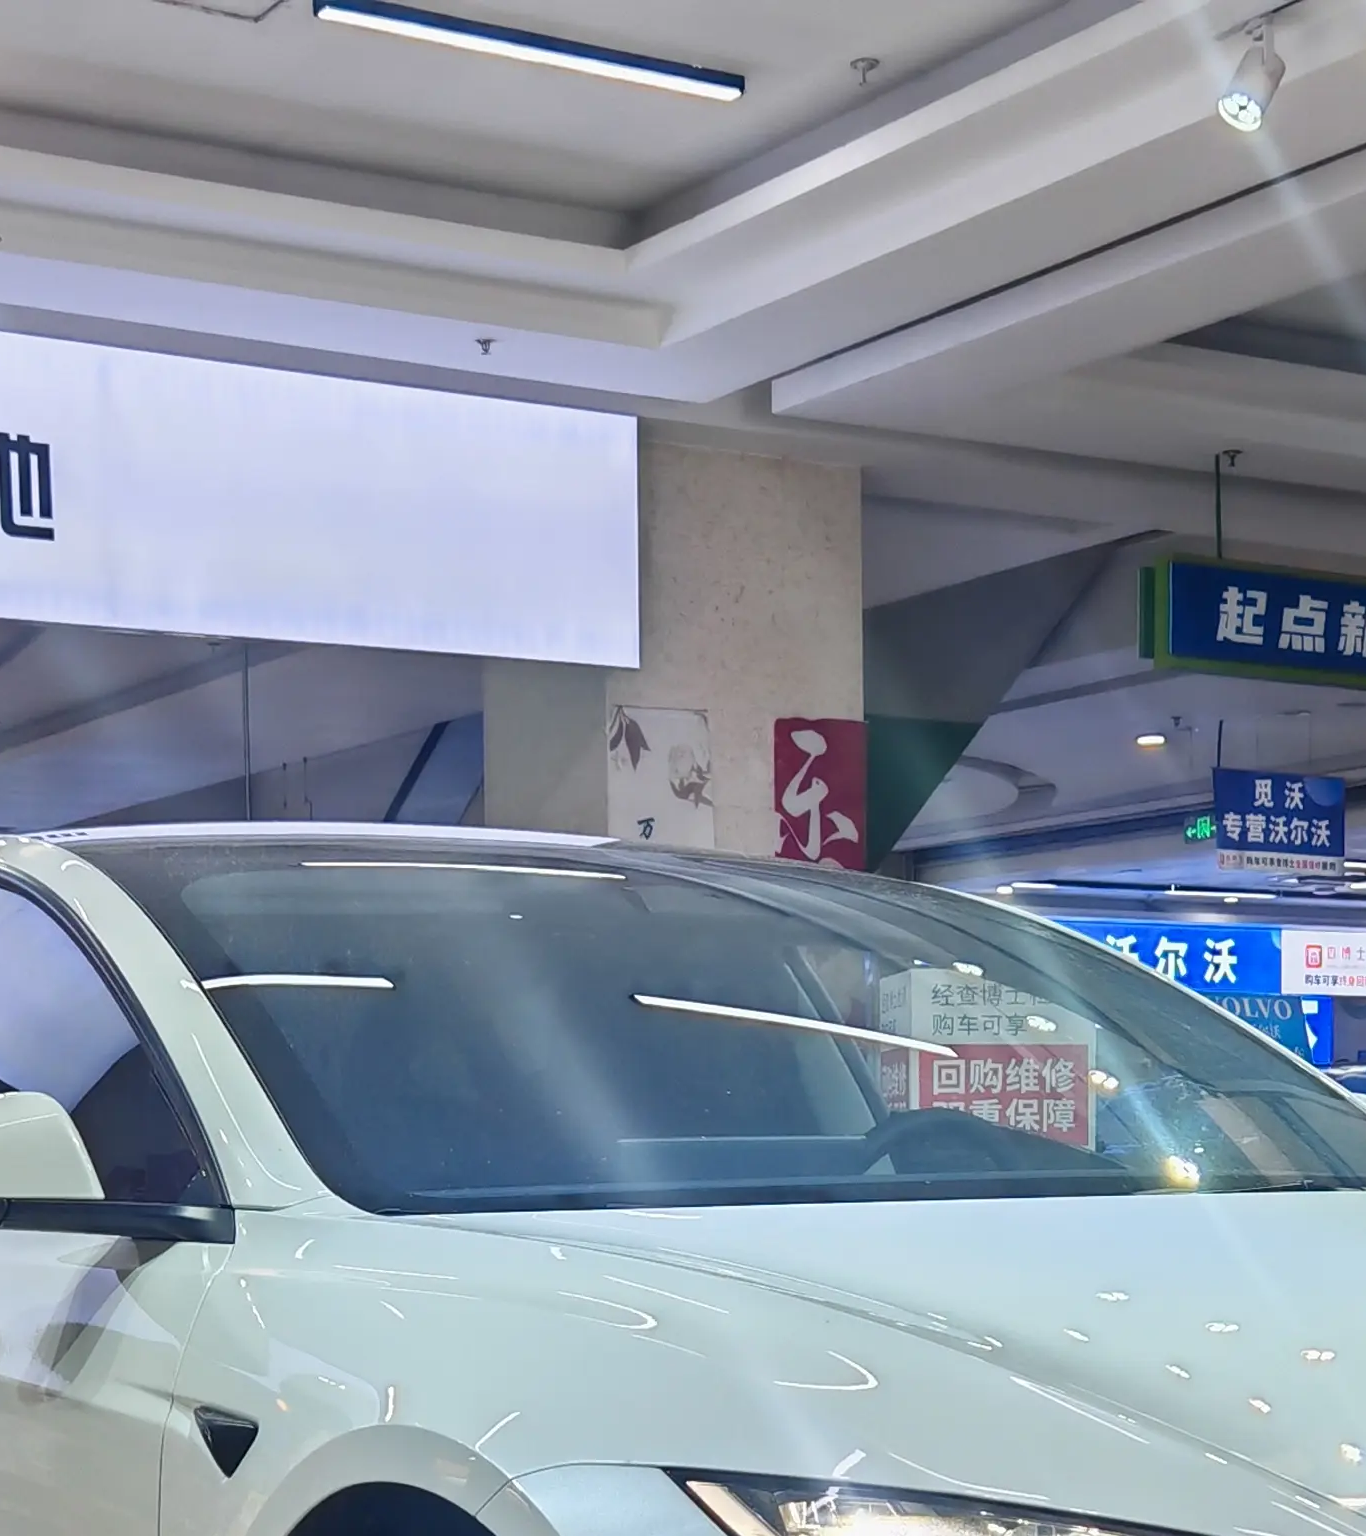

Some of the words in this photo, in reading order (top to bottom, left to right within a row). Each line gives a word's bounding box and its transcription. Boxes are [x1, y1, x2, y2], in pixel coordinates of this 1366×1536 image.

[1254, 778, 1305, 810] 觅沃
[1222, 811, 1331, 848] 专营沃尔沃
[1106, 935, 1237, 984] 沃尔沃
[932, 1013, 1028, 1036] 购车可享
[1219, 995, 1293, 1021] OLVO
[933, 1057, 1076, 1095] 回购维修
